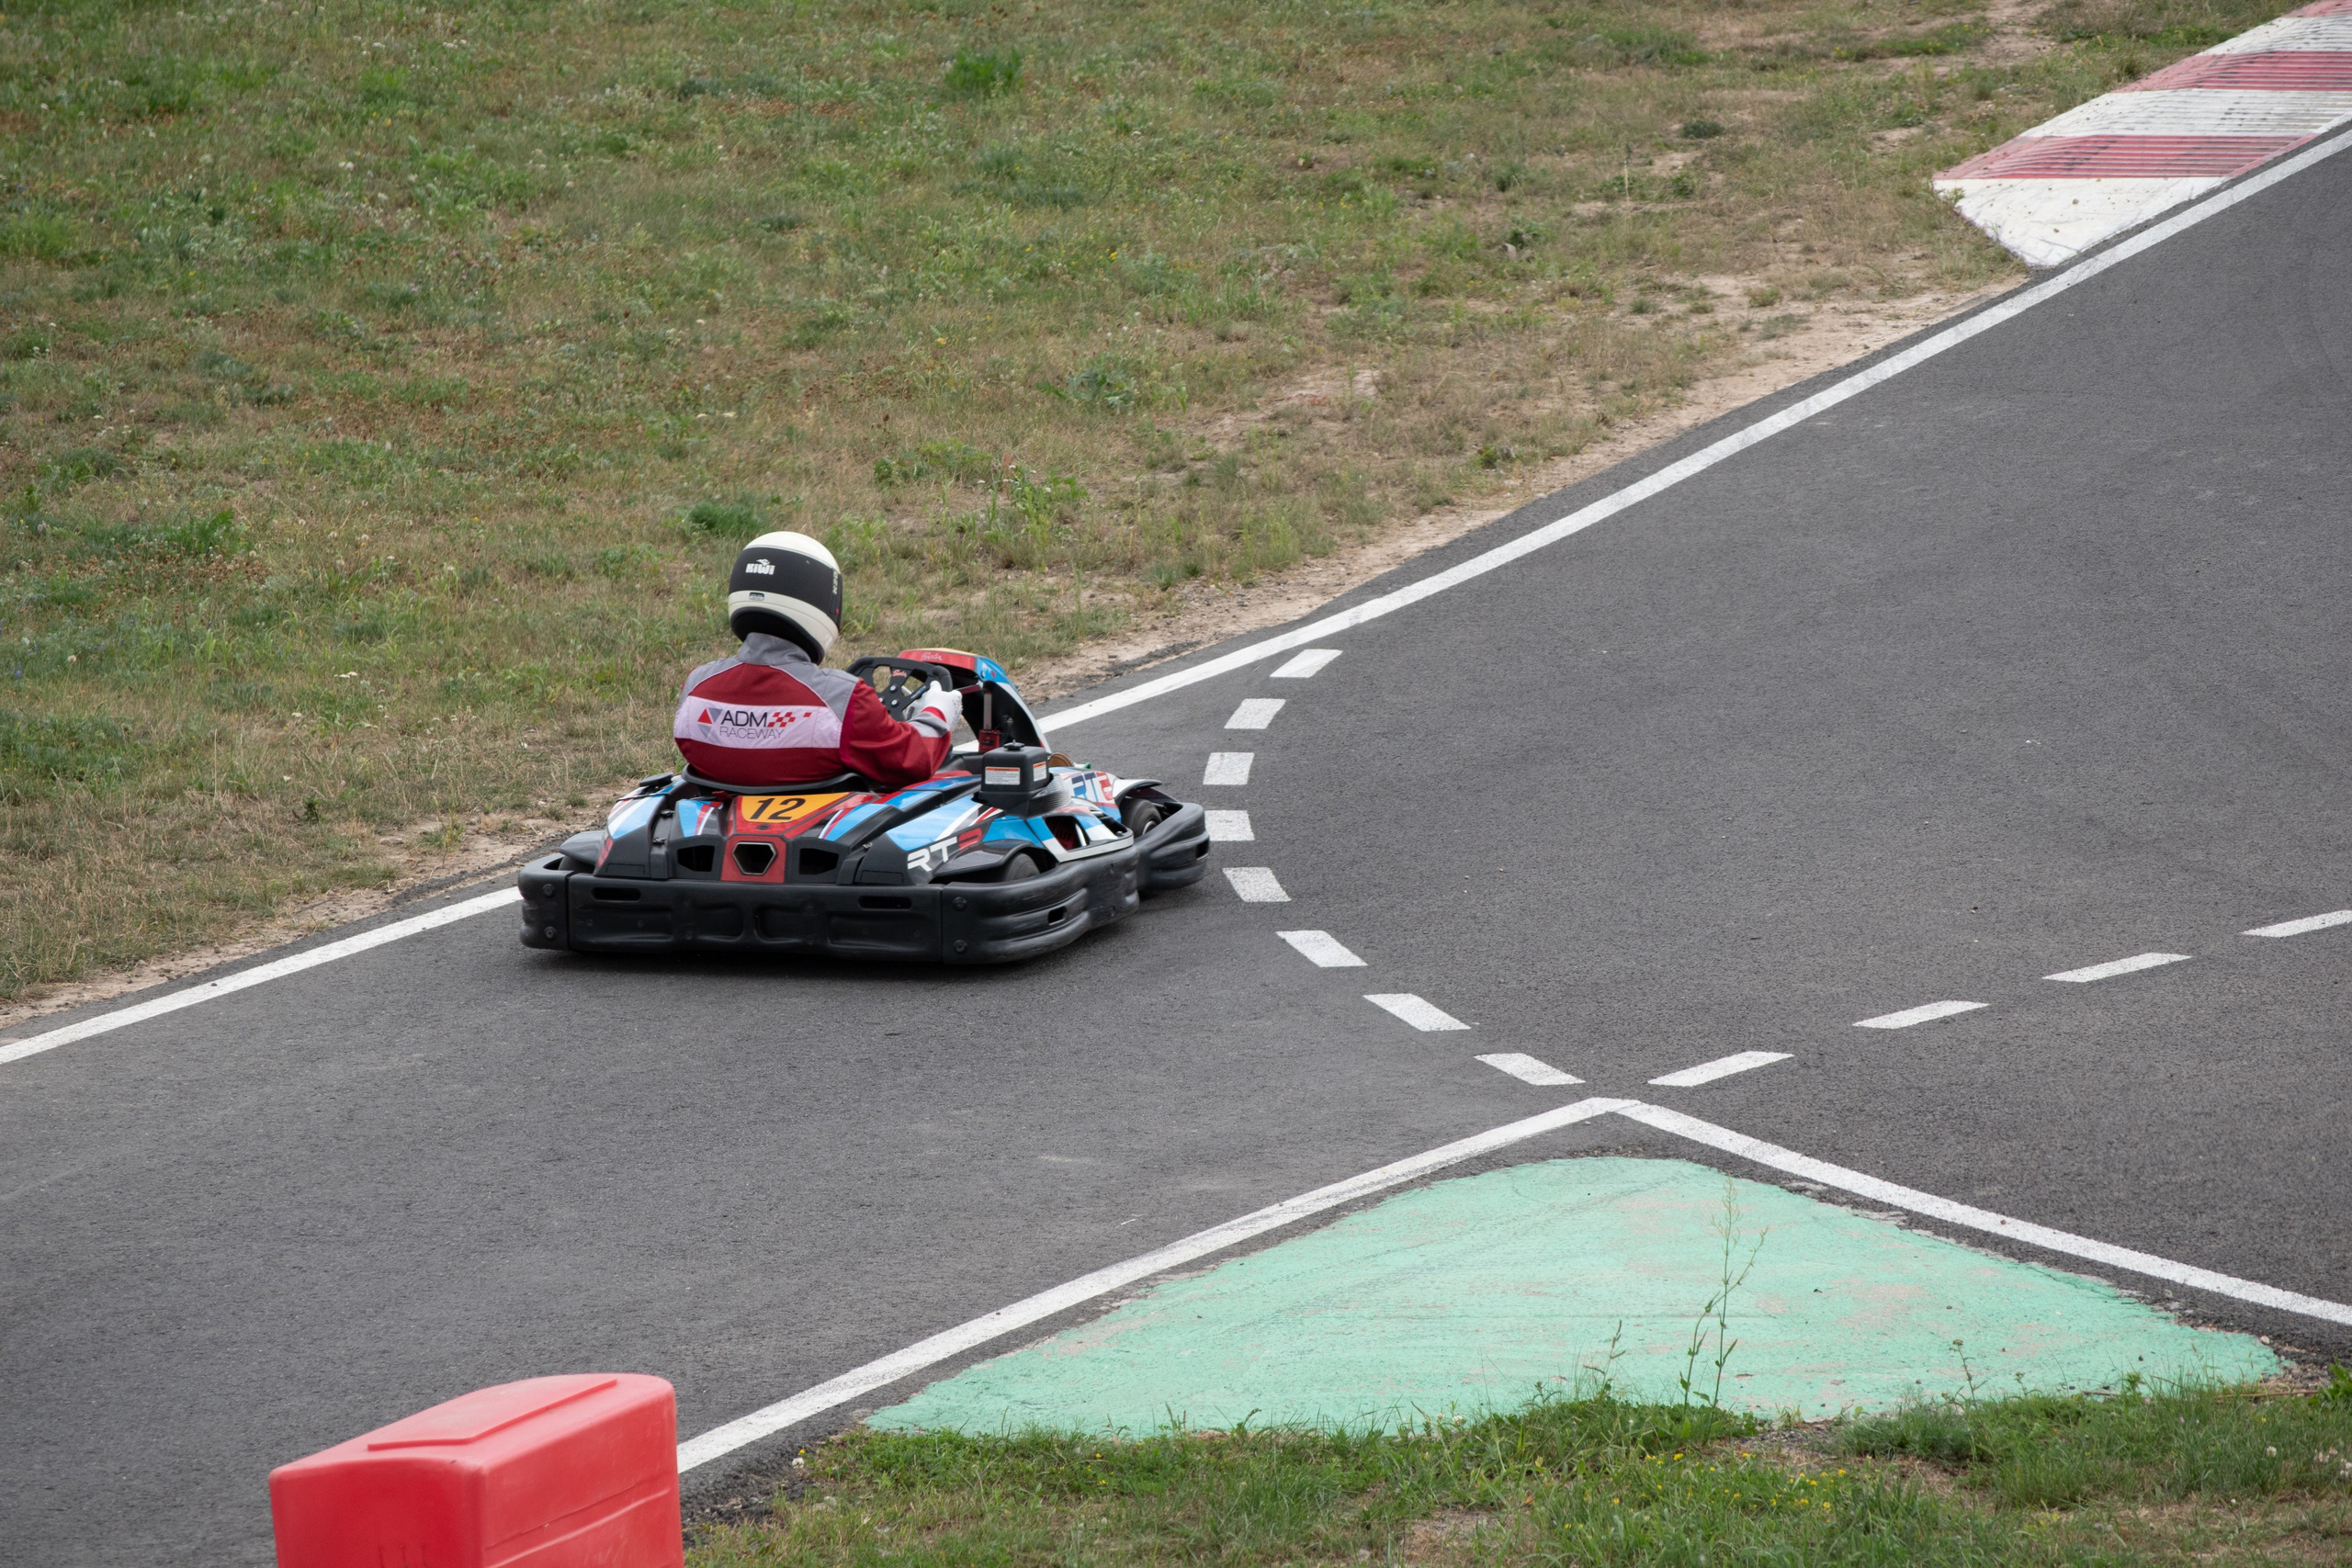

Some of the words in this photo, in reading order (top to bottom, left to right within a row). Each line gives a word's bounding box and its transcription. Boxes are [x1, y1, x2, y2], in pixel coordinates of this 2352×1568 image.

[720, 710, 768, 728] ADM
[719, 727, 785, 739] RACEWAY
[750, 797, 806, 820] 12
